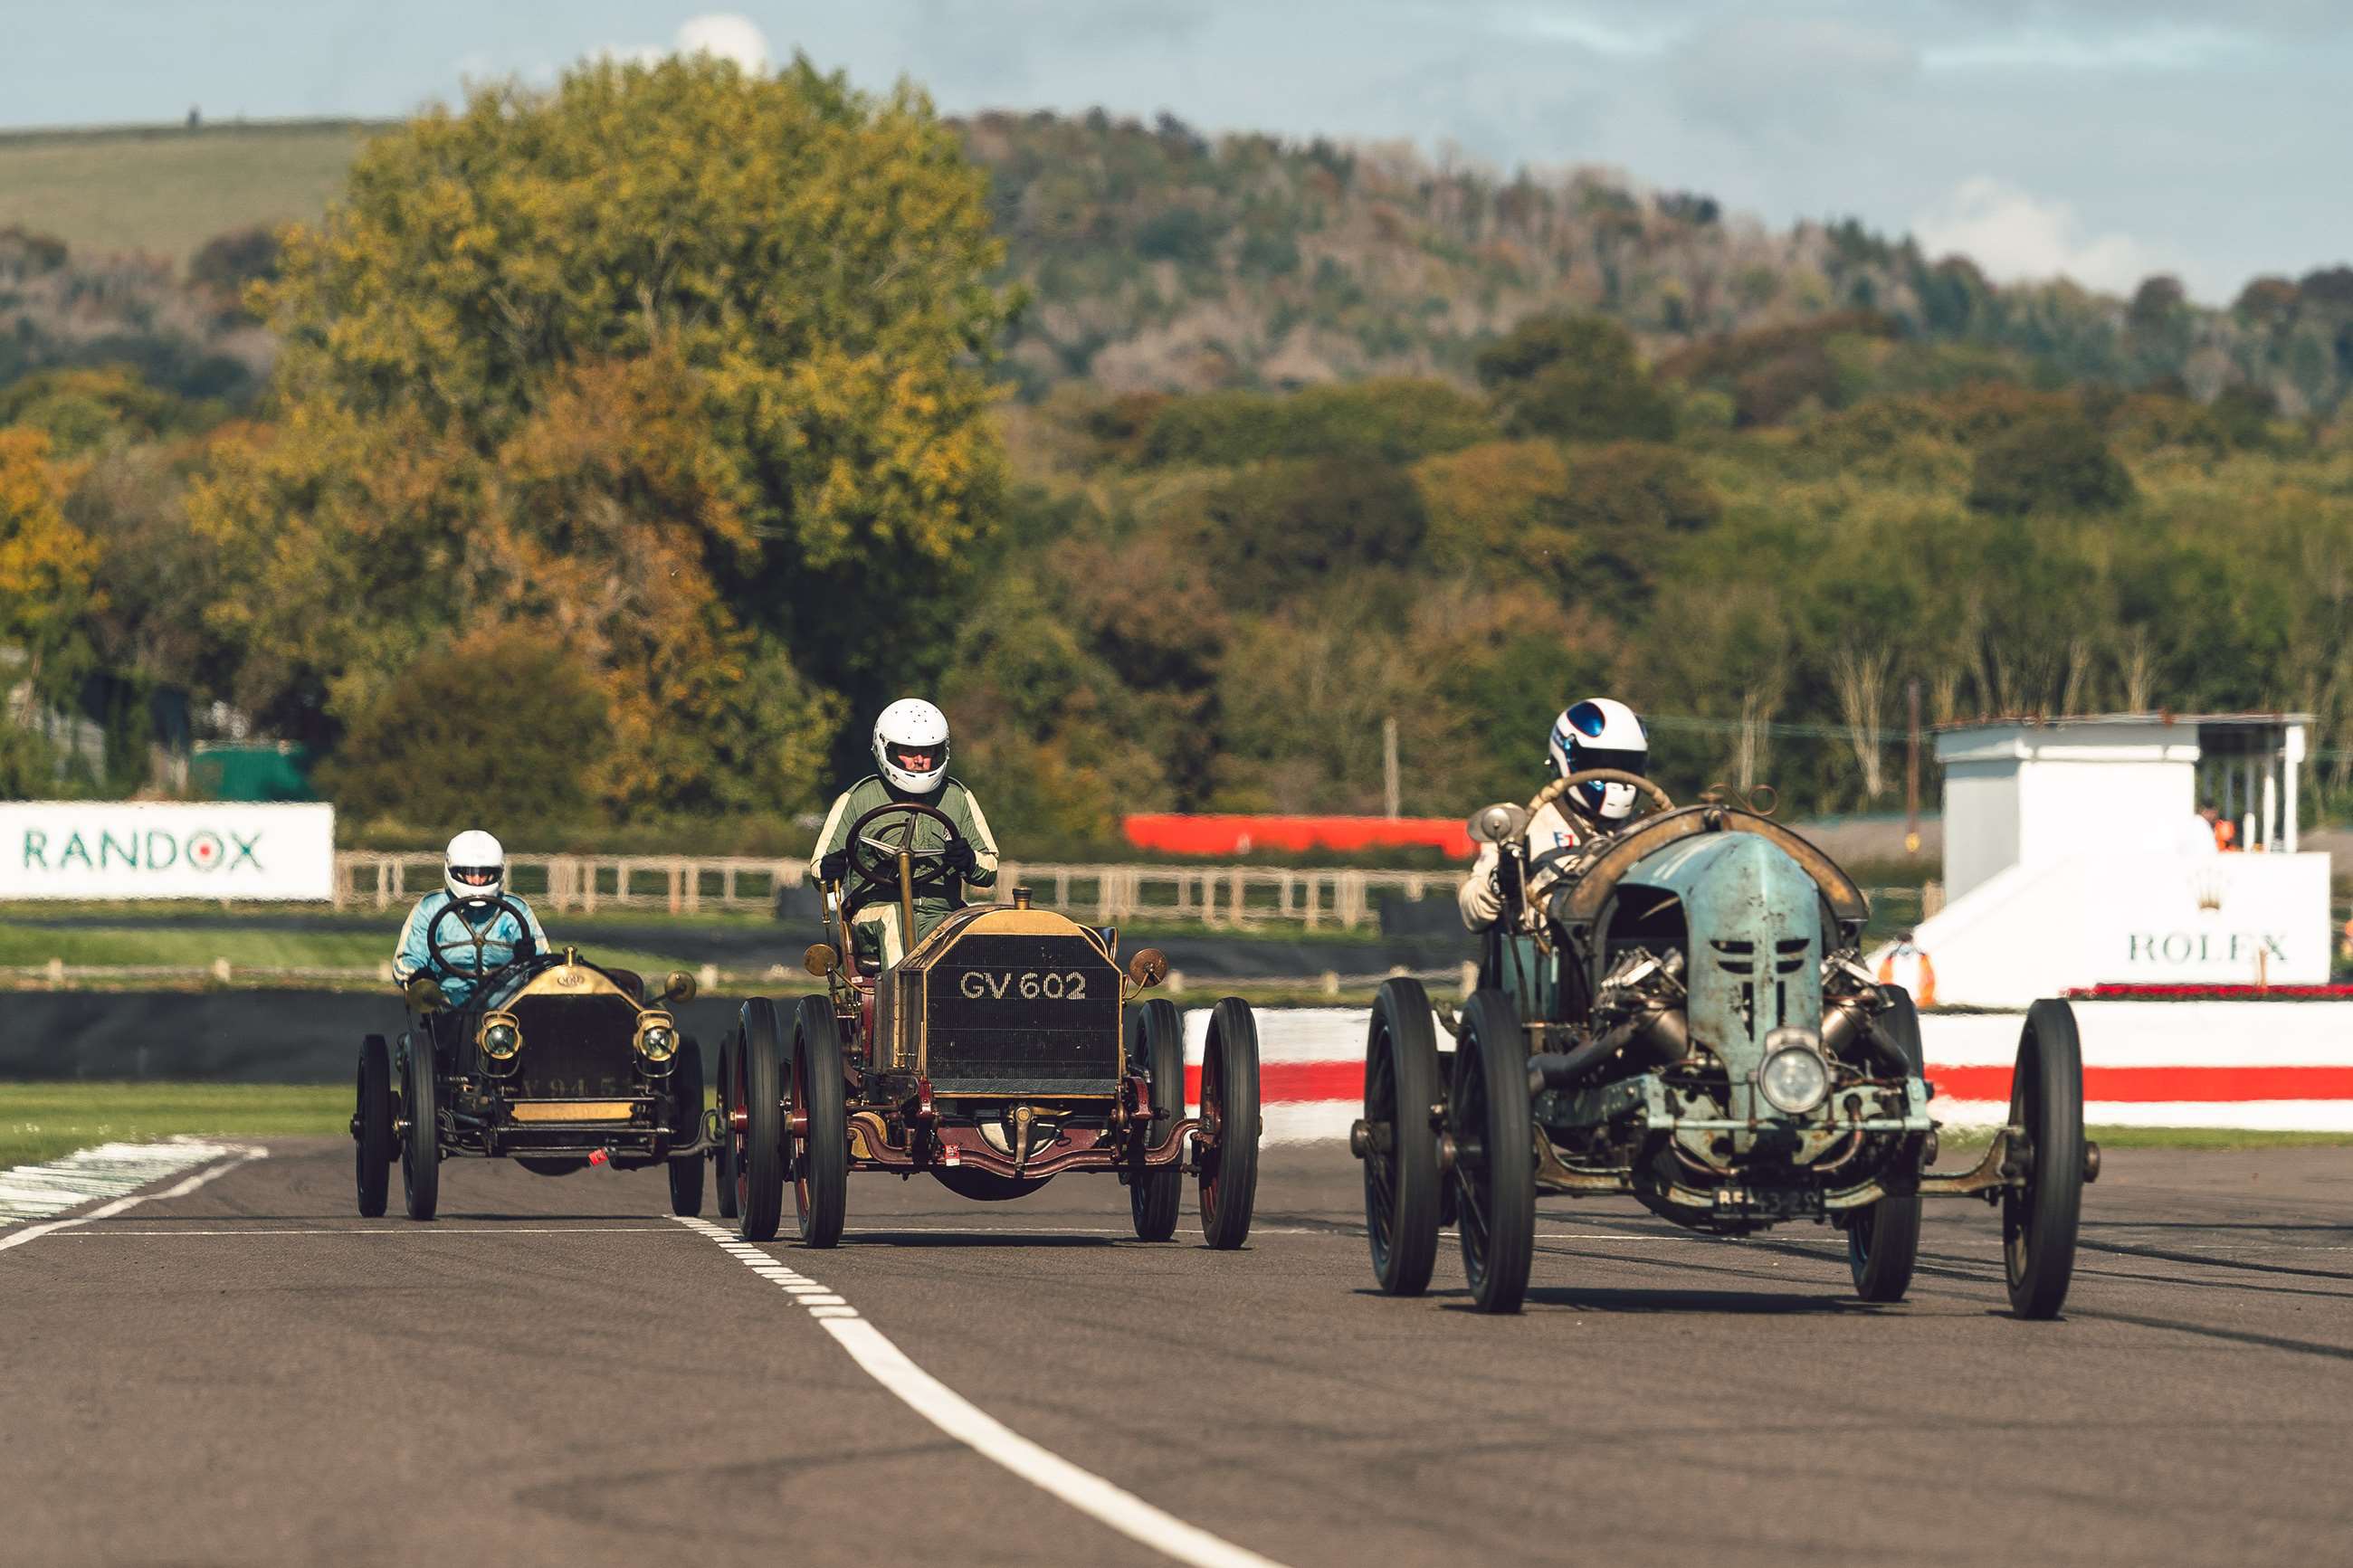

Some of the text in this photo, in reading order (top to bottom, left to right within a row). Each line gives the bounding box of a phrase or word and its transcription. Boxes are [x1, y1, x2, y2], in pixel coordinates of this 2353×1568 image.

[23, 830, 264, 870] RANDOX
[960, 971, 1086, 1000] GV 602
